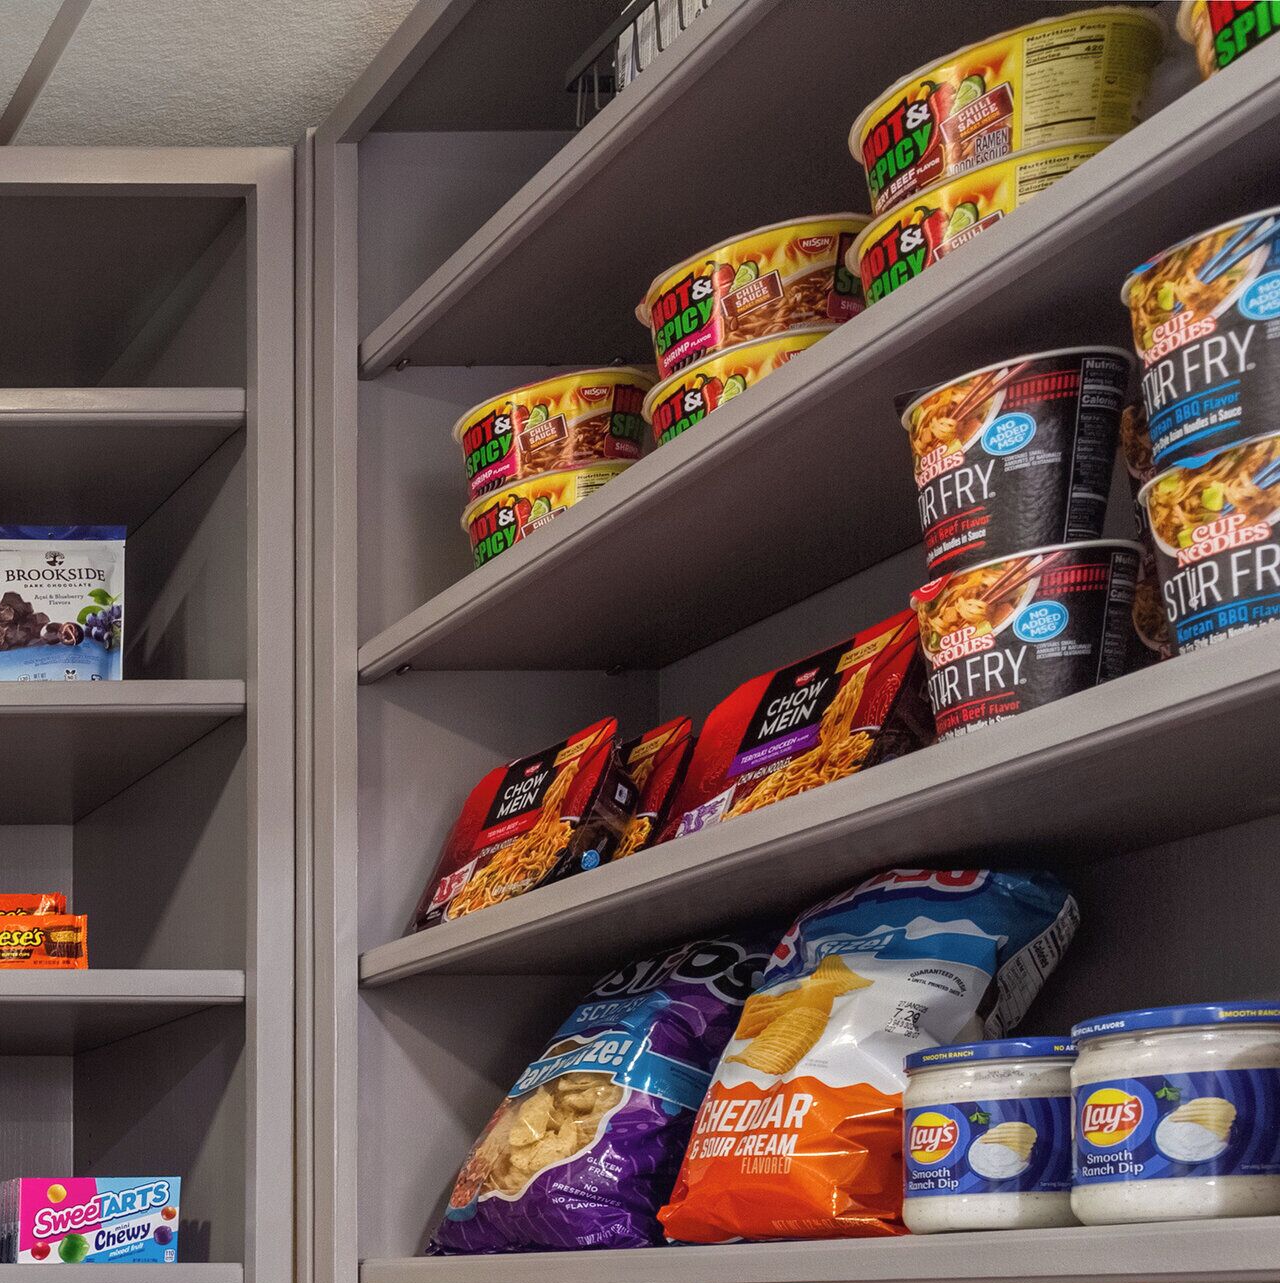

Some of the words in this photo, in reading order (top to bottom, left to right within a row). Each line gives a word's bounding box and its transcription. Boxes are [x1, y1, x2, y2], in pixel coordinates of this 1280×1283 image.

[975, 129, 1008, 152] RAMEN
[889, 169, 916, 194] BEEF
[802, 237, 830, 248] NISSIN
[692, 277, 714, 299] &
[657, 297, 713, 354] SPICY
[663, 341, 690, 367] SHRIMP
[1182, 325, 1256, 392] FRY
[989, 424, 1028, 445] ADDED
[468, 432, 512, 477] SPICY
[939, 459, 995, 513] FRY
[1192, 514, 1246, 543] CUP
[1176, 522, 1271, 568] NOODLES
[5, 568, 105, 582] BROOKSIDE
[1029, 621, 1057, 638] MSG
[1177, 618, 1214, 642] Korean
[1218, 607, 1249, 625] BBQ
[765, 678, 829, 717] CHOW
[757, 701, 818, 740] MEIN
[740, 745, 769, 766] TERIYAKI
[768, 736, 797, 755] CHICKEN
[922, 1053, 947, 1061] SMOOTH
[948, 1051, 974, 1059] RANCH
[698, 1094, 813, 1133] CHEDDAR
[702, 1139, 736, 1158] SOUR
[739, 1134, 798, 1157] CREAM
[910, 1124, 955, 1152] Lay's
[741, 1156, 791, 1174] FLAVORED
[1086, 1151, 1132, 1164] Smooth
[912, 1168, 950, 1179] Smooth
[1082, 1164, 1115, 1177] Ranch
[938, 1178, 959, 1190] Dip
[33, 1180, 170, 1237] SweeTARTS
[95, 1222, 151, 1251] Chewy
[115, 1223, 130, 1232] mini
